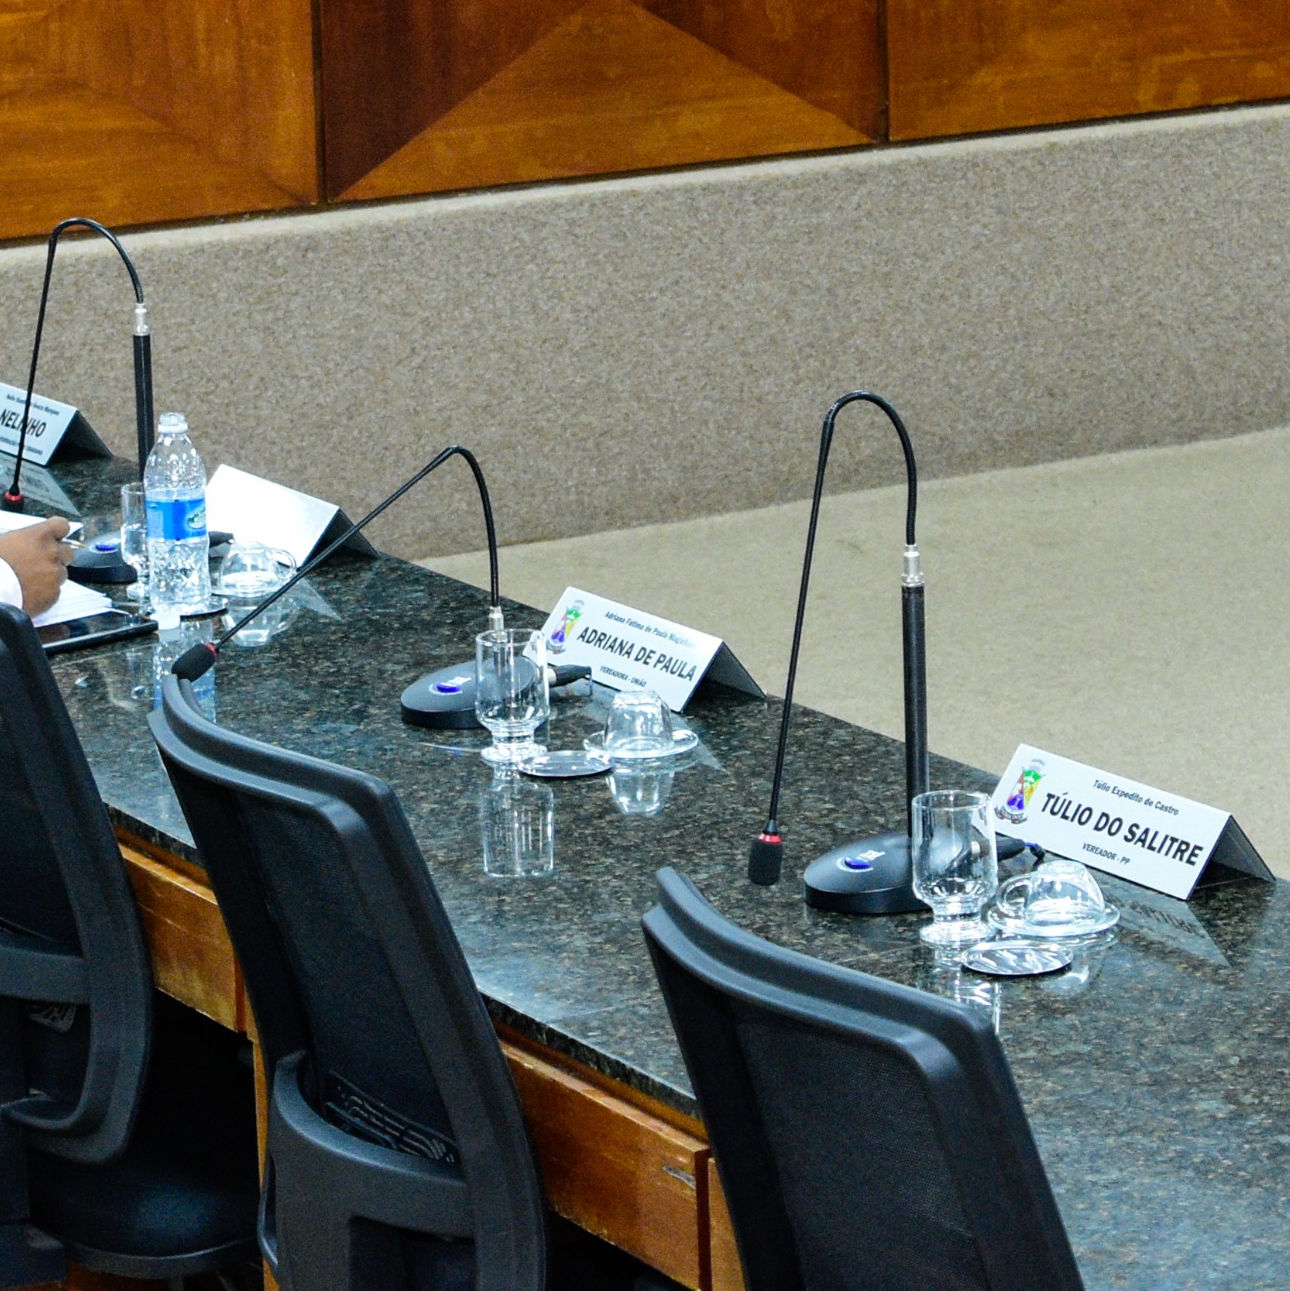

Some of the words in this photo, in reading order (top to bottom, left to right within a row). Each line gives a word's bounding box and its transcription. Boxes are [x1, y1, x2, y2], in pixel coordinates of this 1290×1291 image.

[605, 611, 626, 625] Adriana
[644, 624, 653, 633] de
[653, 627, 669, 639] Paula
[577, 626, 635, 659] ADRIANA
[634, 646, 657, 666] DE
[653, 654, 698, 682] PAULA
[600, 665, 628, 681] VEREADORA
[630, 676, 647, 688] UNIÃO
[1093, 779, 1111, 793] Túlio
[1111, 785, 1144, 805] Expedito
[1144, 796, 1155, 807] de
[1154, 800, 1179, 816] Castro
[1040, 791, 1094, 826] TÚLIO
[1093, 811, 1124, 837] DO
[1123, 823, 1205, 867] SALITRE
[1082, 842, 1117, 862] VEREADOR
[1120, 856, 1131, 867] PP
